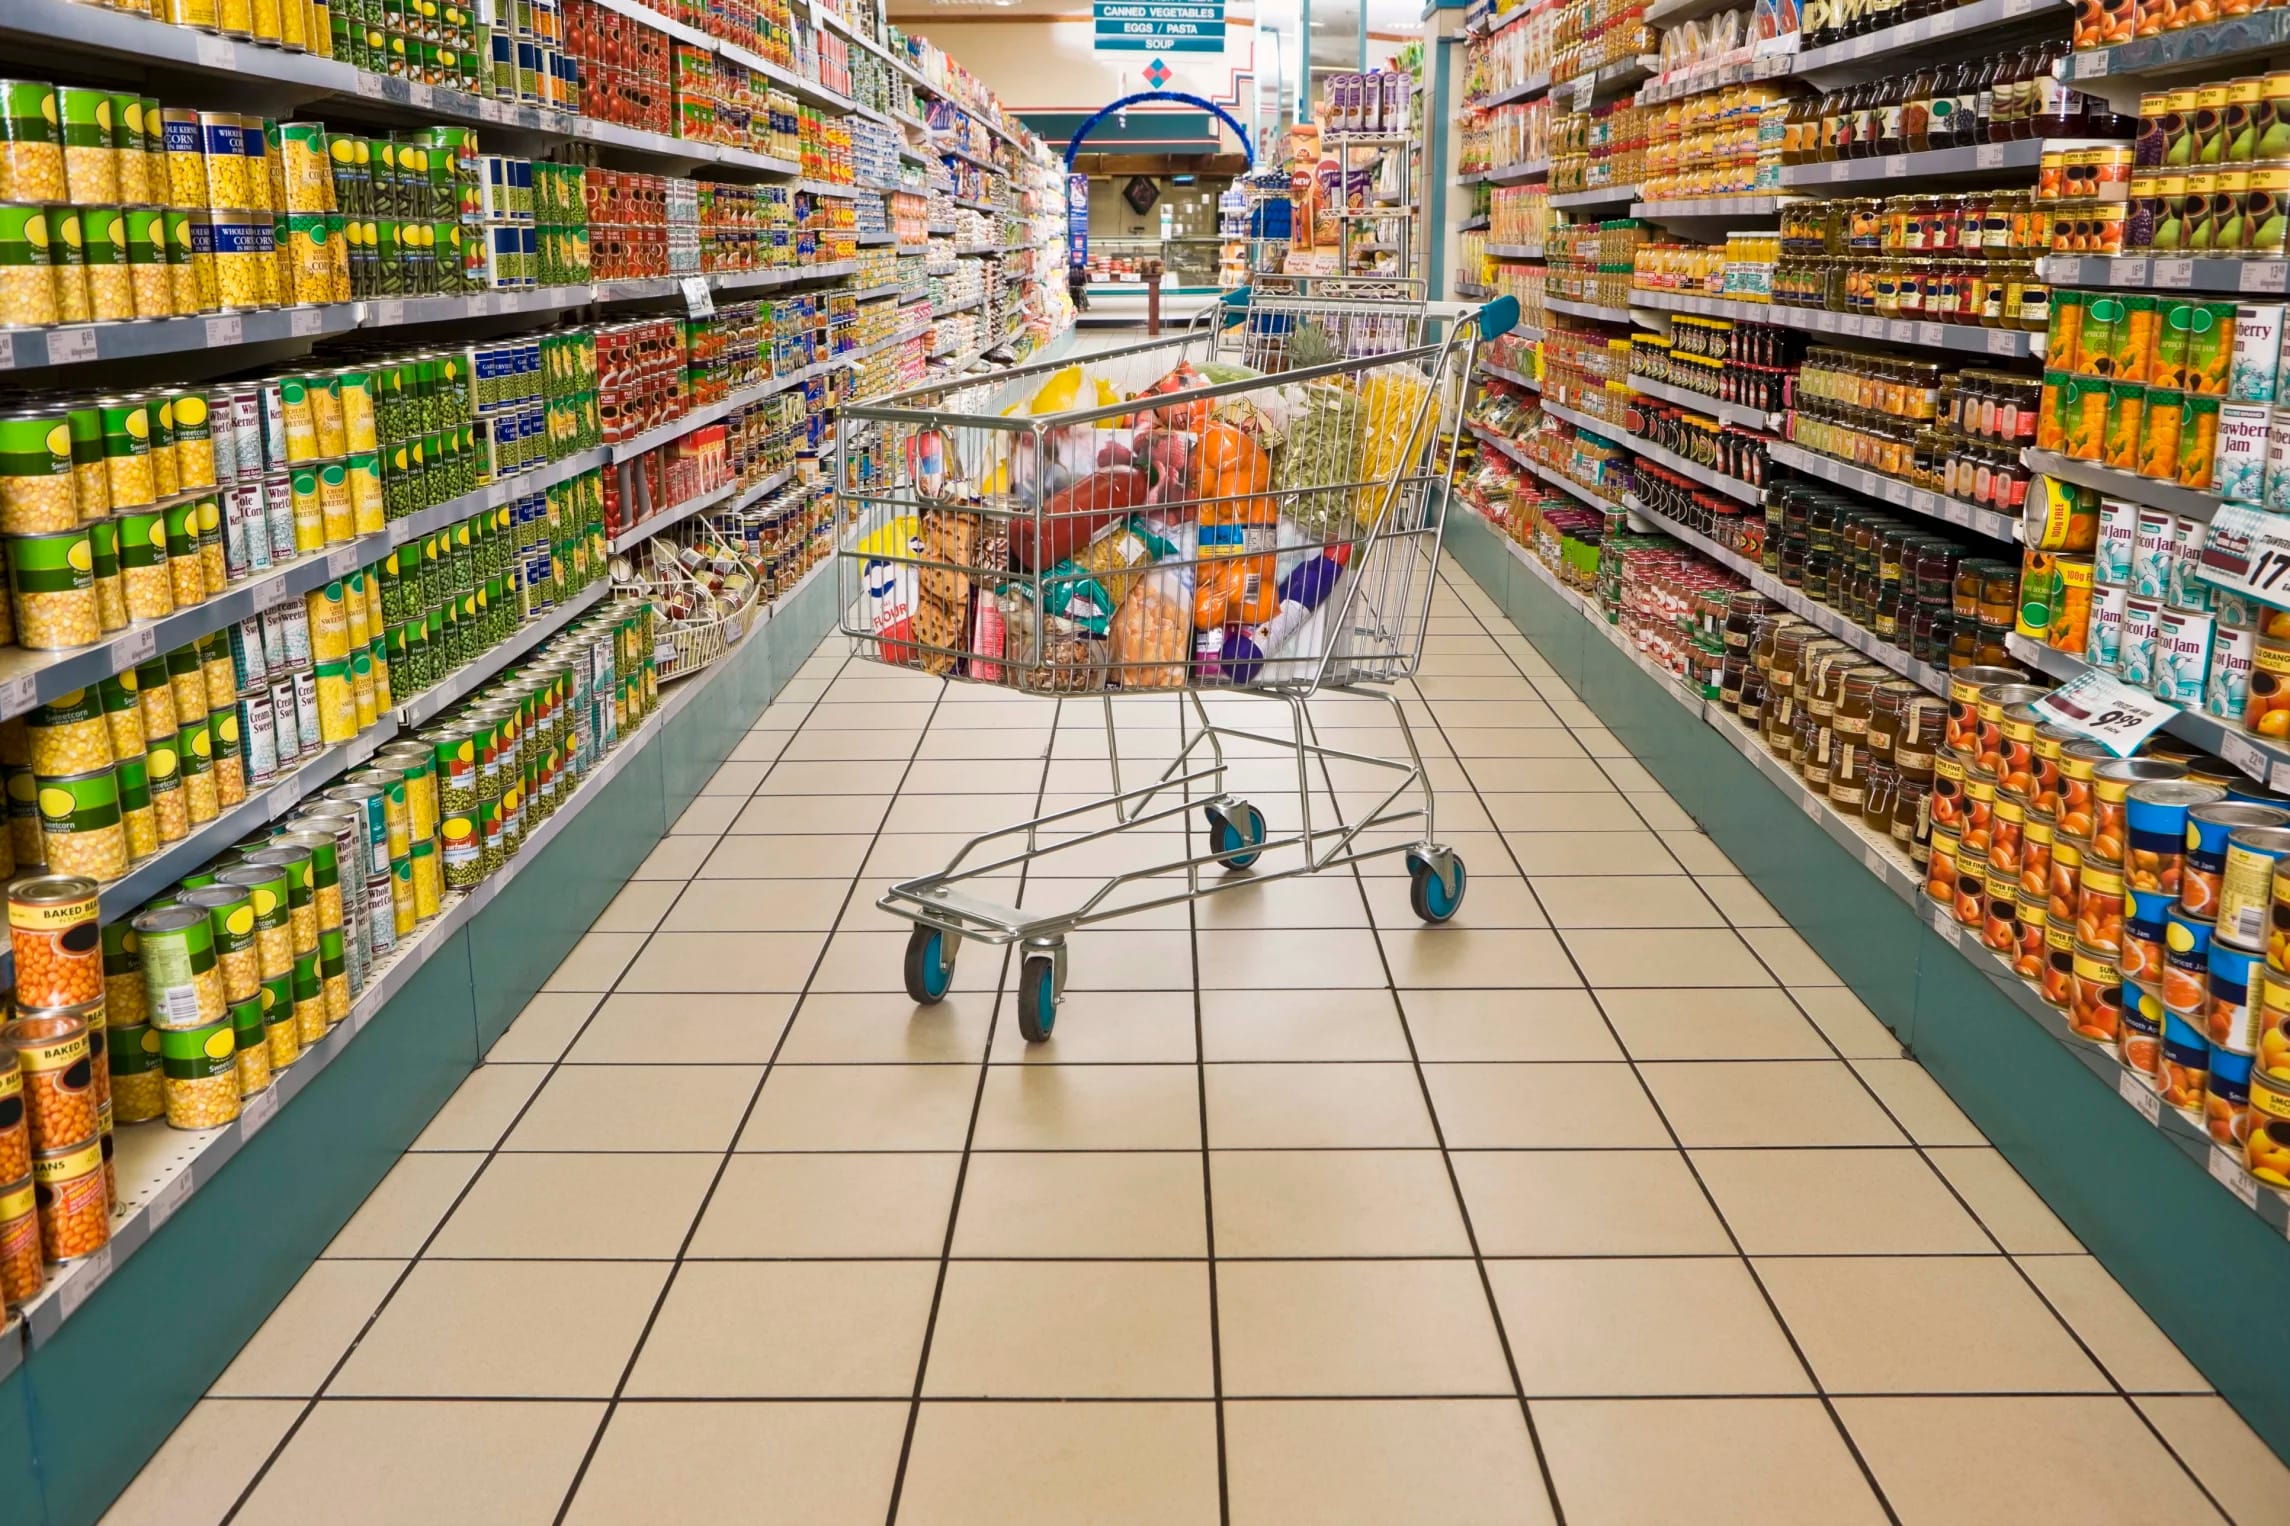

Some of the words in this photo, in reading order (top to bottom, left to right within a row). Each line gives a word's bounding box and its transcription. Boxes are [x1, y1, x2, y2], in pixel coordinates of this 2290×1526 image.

[1103, 6, 1146, 17] CANNED
[1149, 7, 1215, 18] VEGETABLES
[1124, 22, 1153, 33] EGGS
[1166, 24, 1198, 34] PASTA
[1145, 39, 1175, 49] SOUP
[1292, 177, 1311, 186] NEW
[2224, 436, 2250, 452] Jam
[2055, 504, 2064, 524] FREE
[2109, 525, 2131, 539] Jam
[2067, 570, 2084, 582] 100g
[873, 602, 908, 628] FLOUR
[2100, 608, 2121, 624] Jam
[2174, 638, 2200, 654] Jam
[2226, 654, 2252, 671] Jam
[1950, 764, 1960, 772] FINE
[1958, 858, 1970, 867] SUPER
[1972, 861, 1986, 870] FINE
[2201, 862, 2216, 871] Jam
[1990, 881, 2006, 890] SUPER
[44, 906, 82, 918] BAKED
[44, 1042, 80, 1058] BAKED
